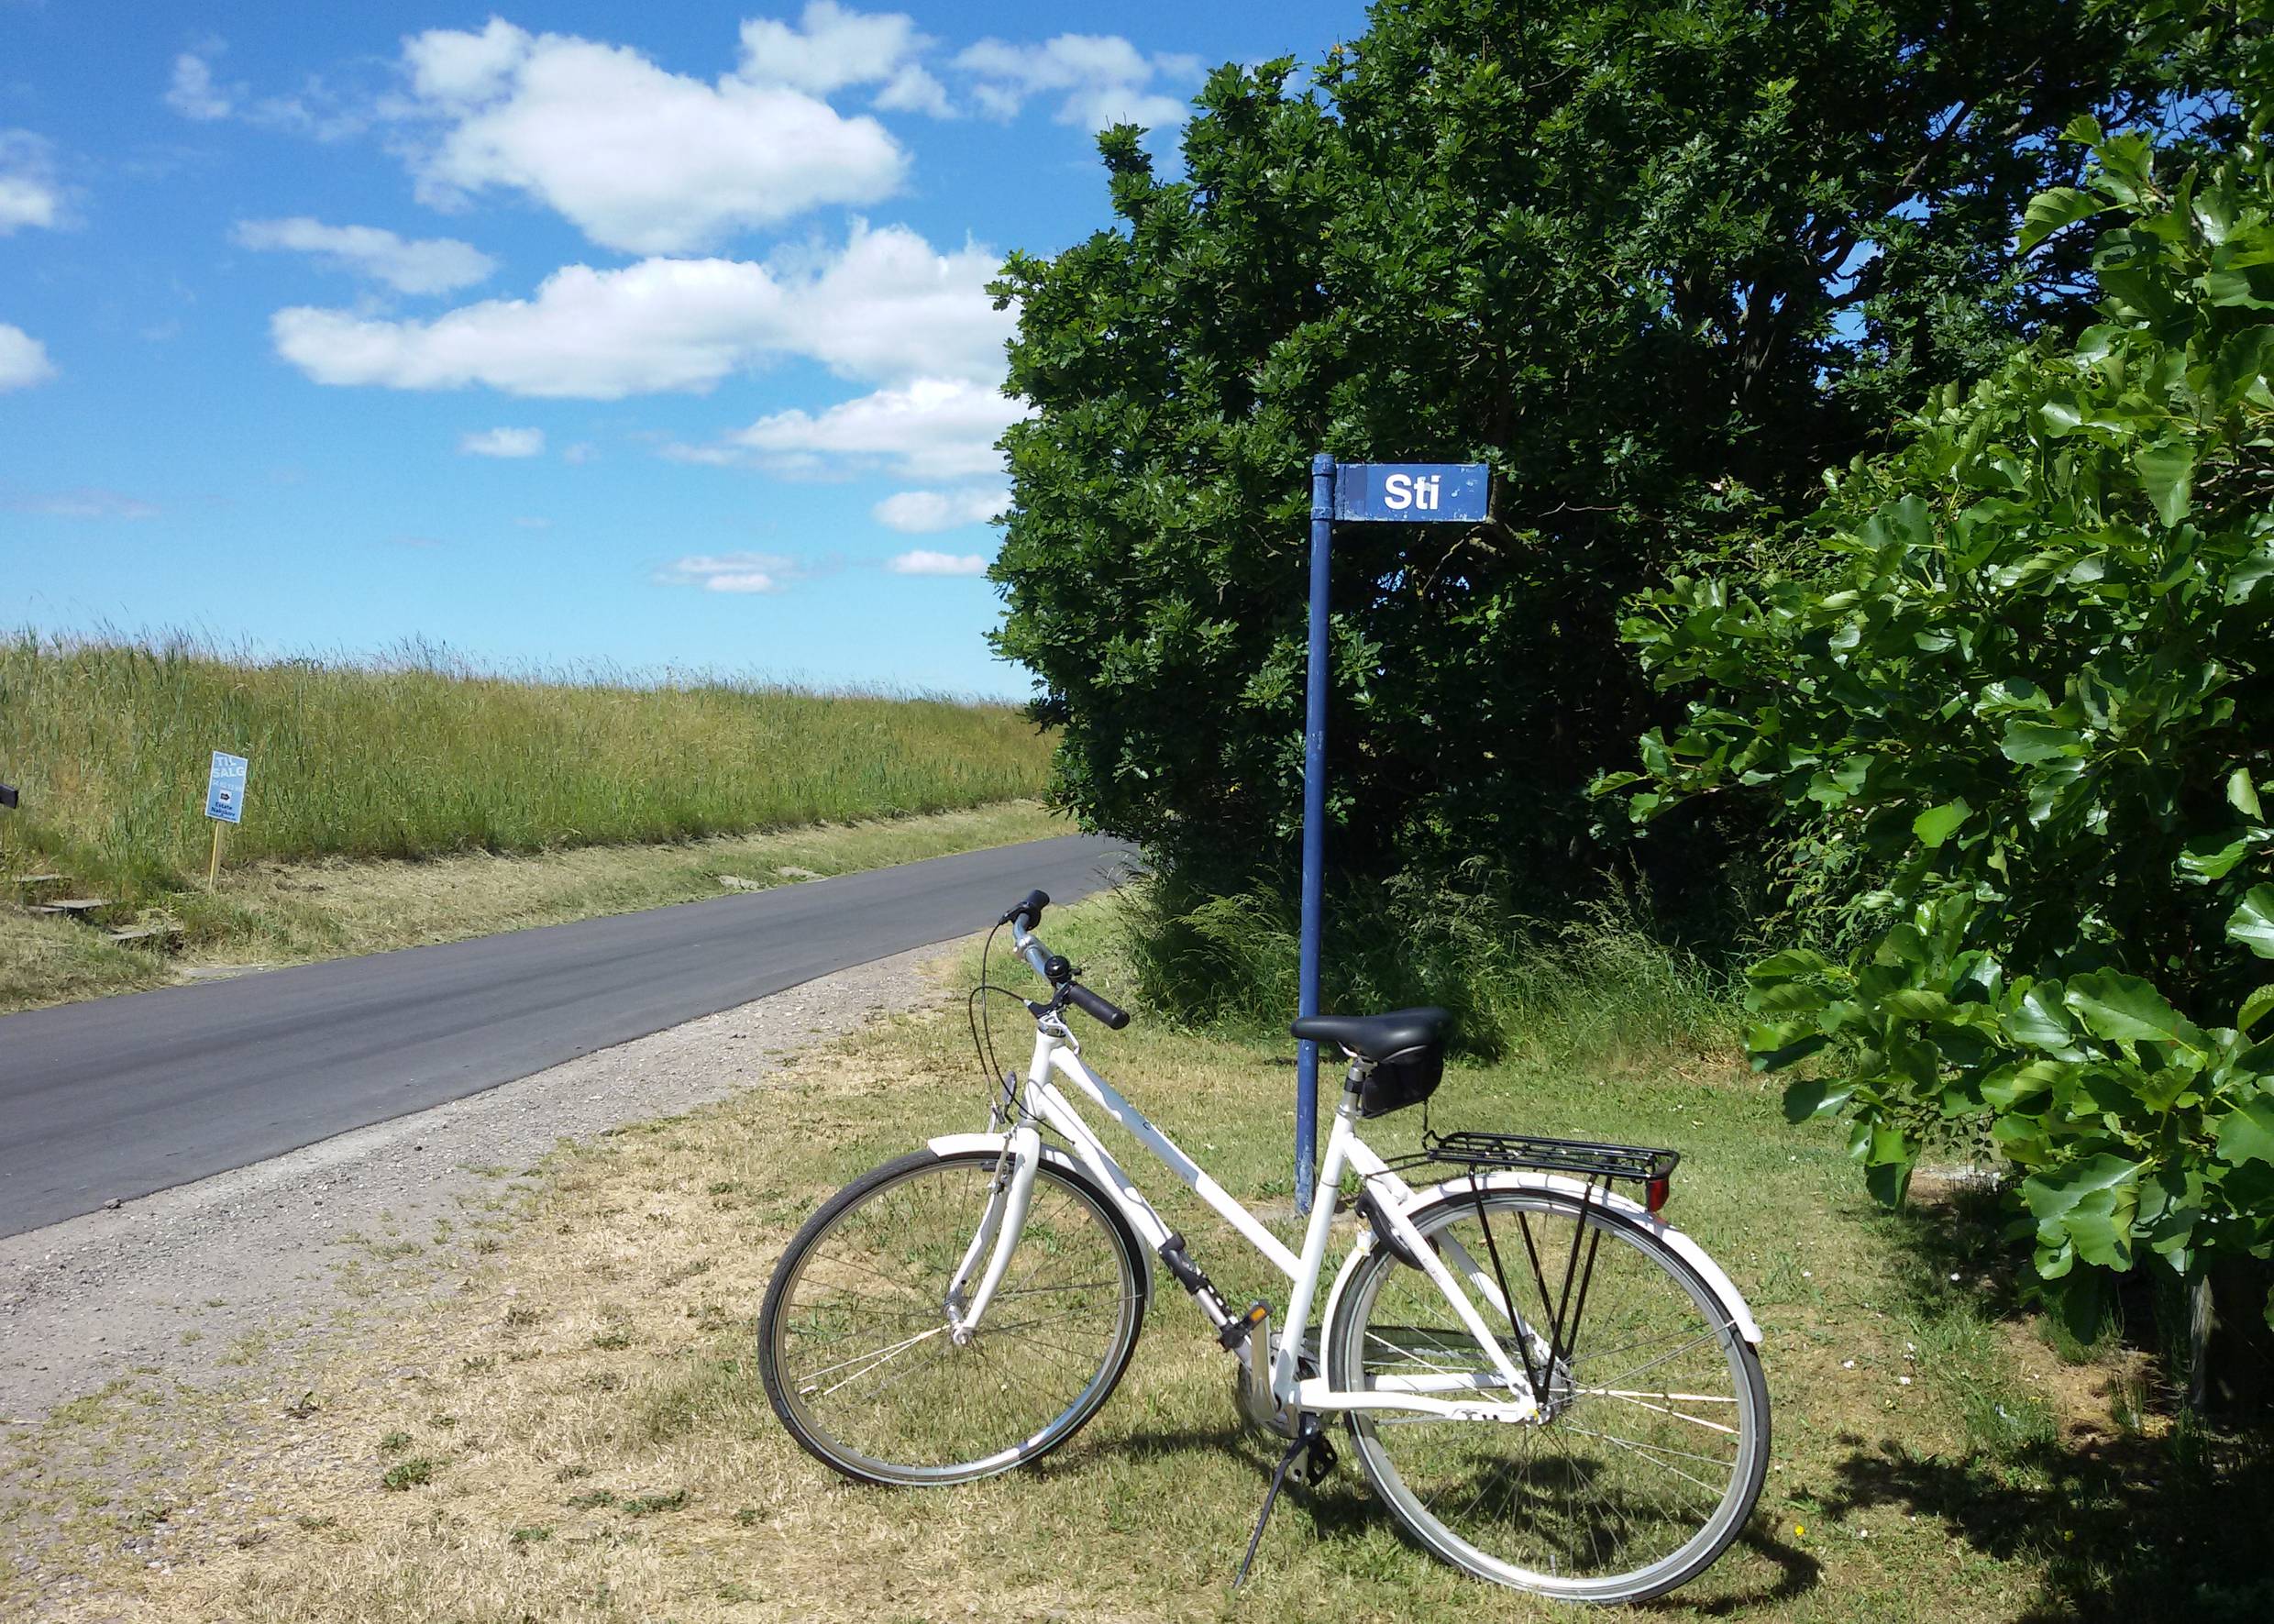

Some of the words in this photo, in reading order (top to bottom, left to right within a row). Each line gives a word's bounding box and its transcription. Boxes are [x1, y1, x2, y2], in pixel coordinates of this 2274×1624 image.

[1385, 473, 1441, 510] Sti
[215, 756, 237, 767] TIL
[212, 767, 244, 779] SALG
